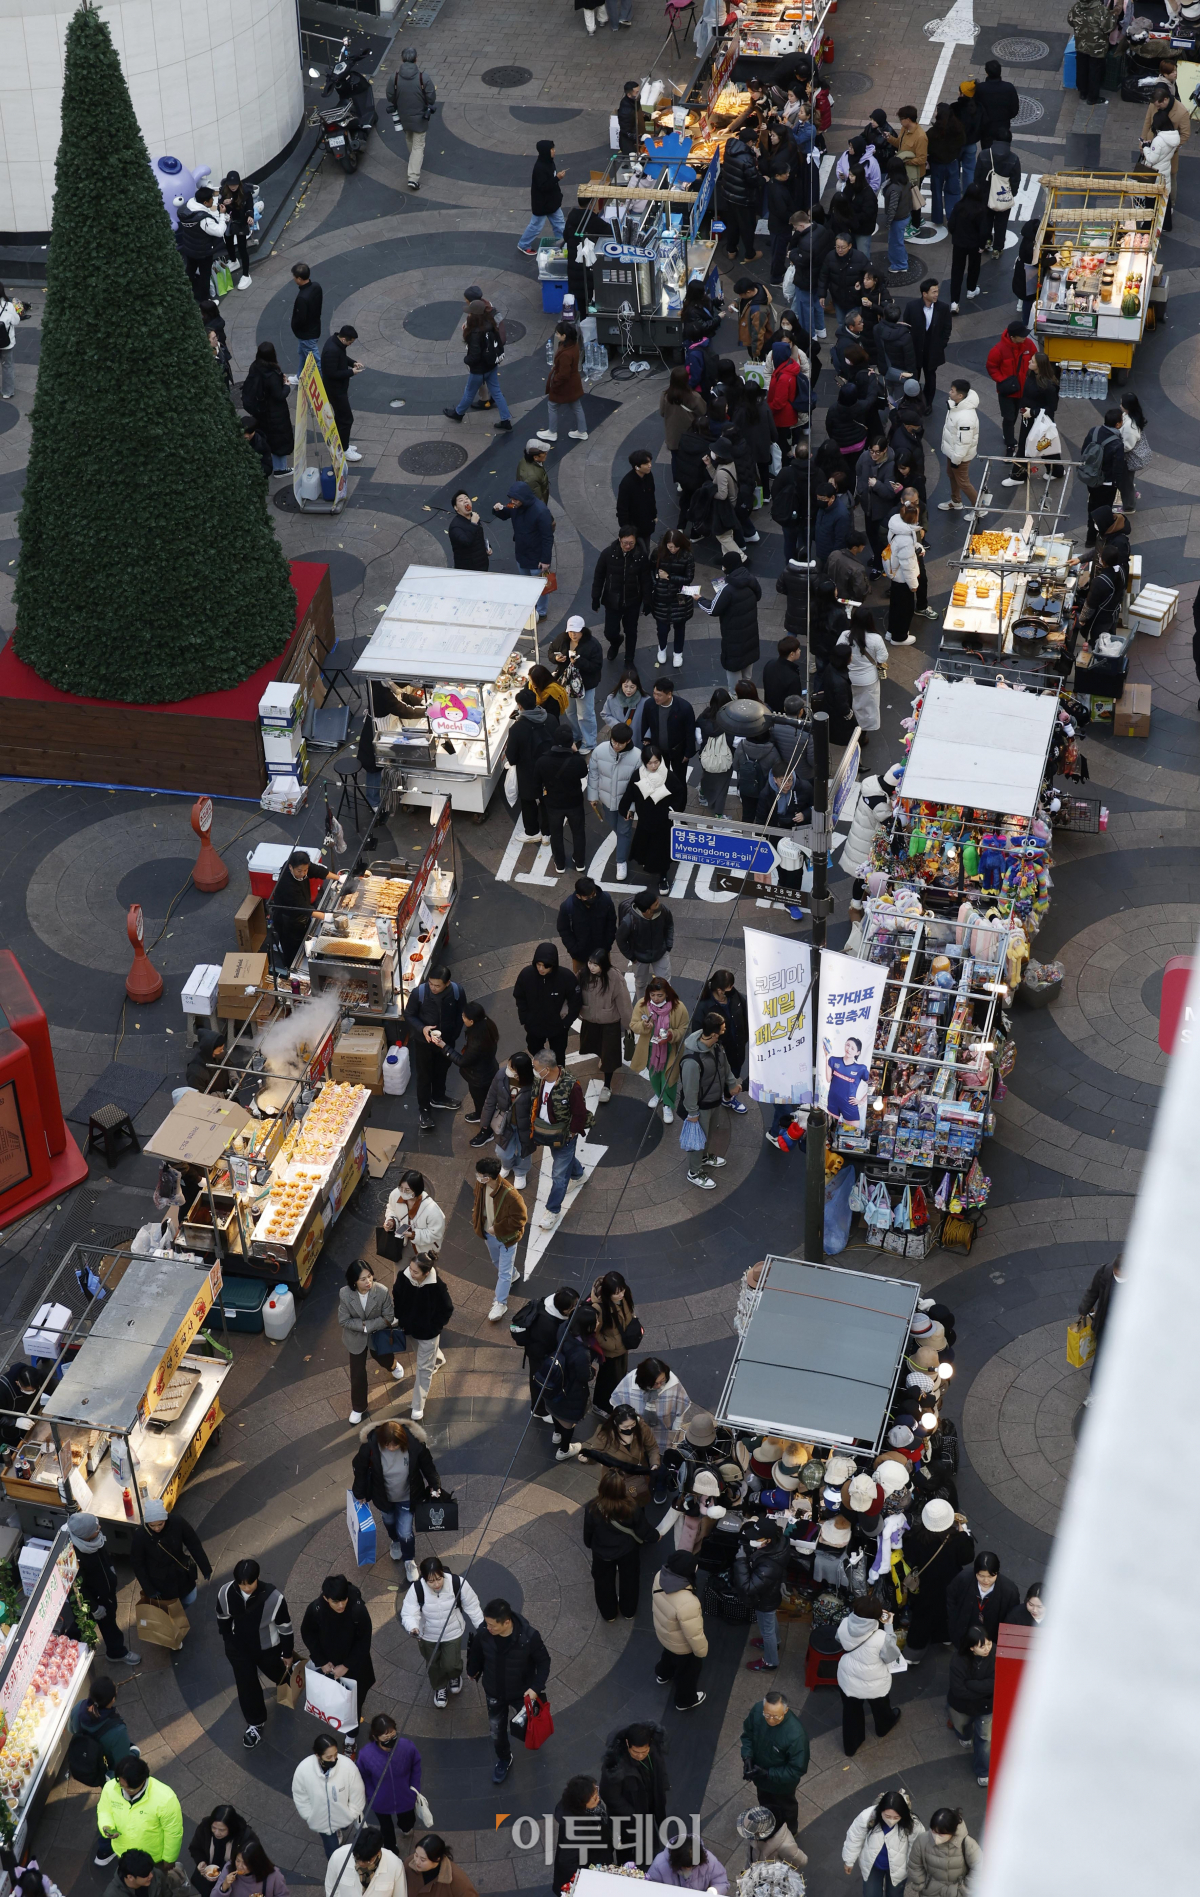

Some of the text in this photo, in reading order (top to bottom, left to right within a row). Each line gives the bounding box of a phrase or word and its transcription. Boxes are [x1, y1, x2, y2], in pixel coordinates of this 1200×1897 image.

[604, 242, 655, 258] OREO
[437, 721, 463, 731] Mochi
[675, 830, 716, 847] 명동8길
[675, 843, 752, 862] Myeongdong 8-gil
[754, 963, 805, 996] 코리아
[762, 990, 796, 1019] 세일
[827, 986, 876, 1008] 국가대표
[826, 1006, 872, 1026] 쇼핑축제
[755, 1010, 806, 1046] 페스타
